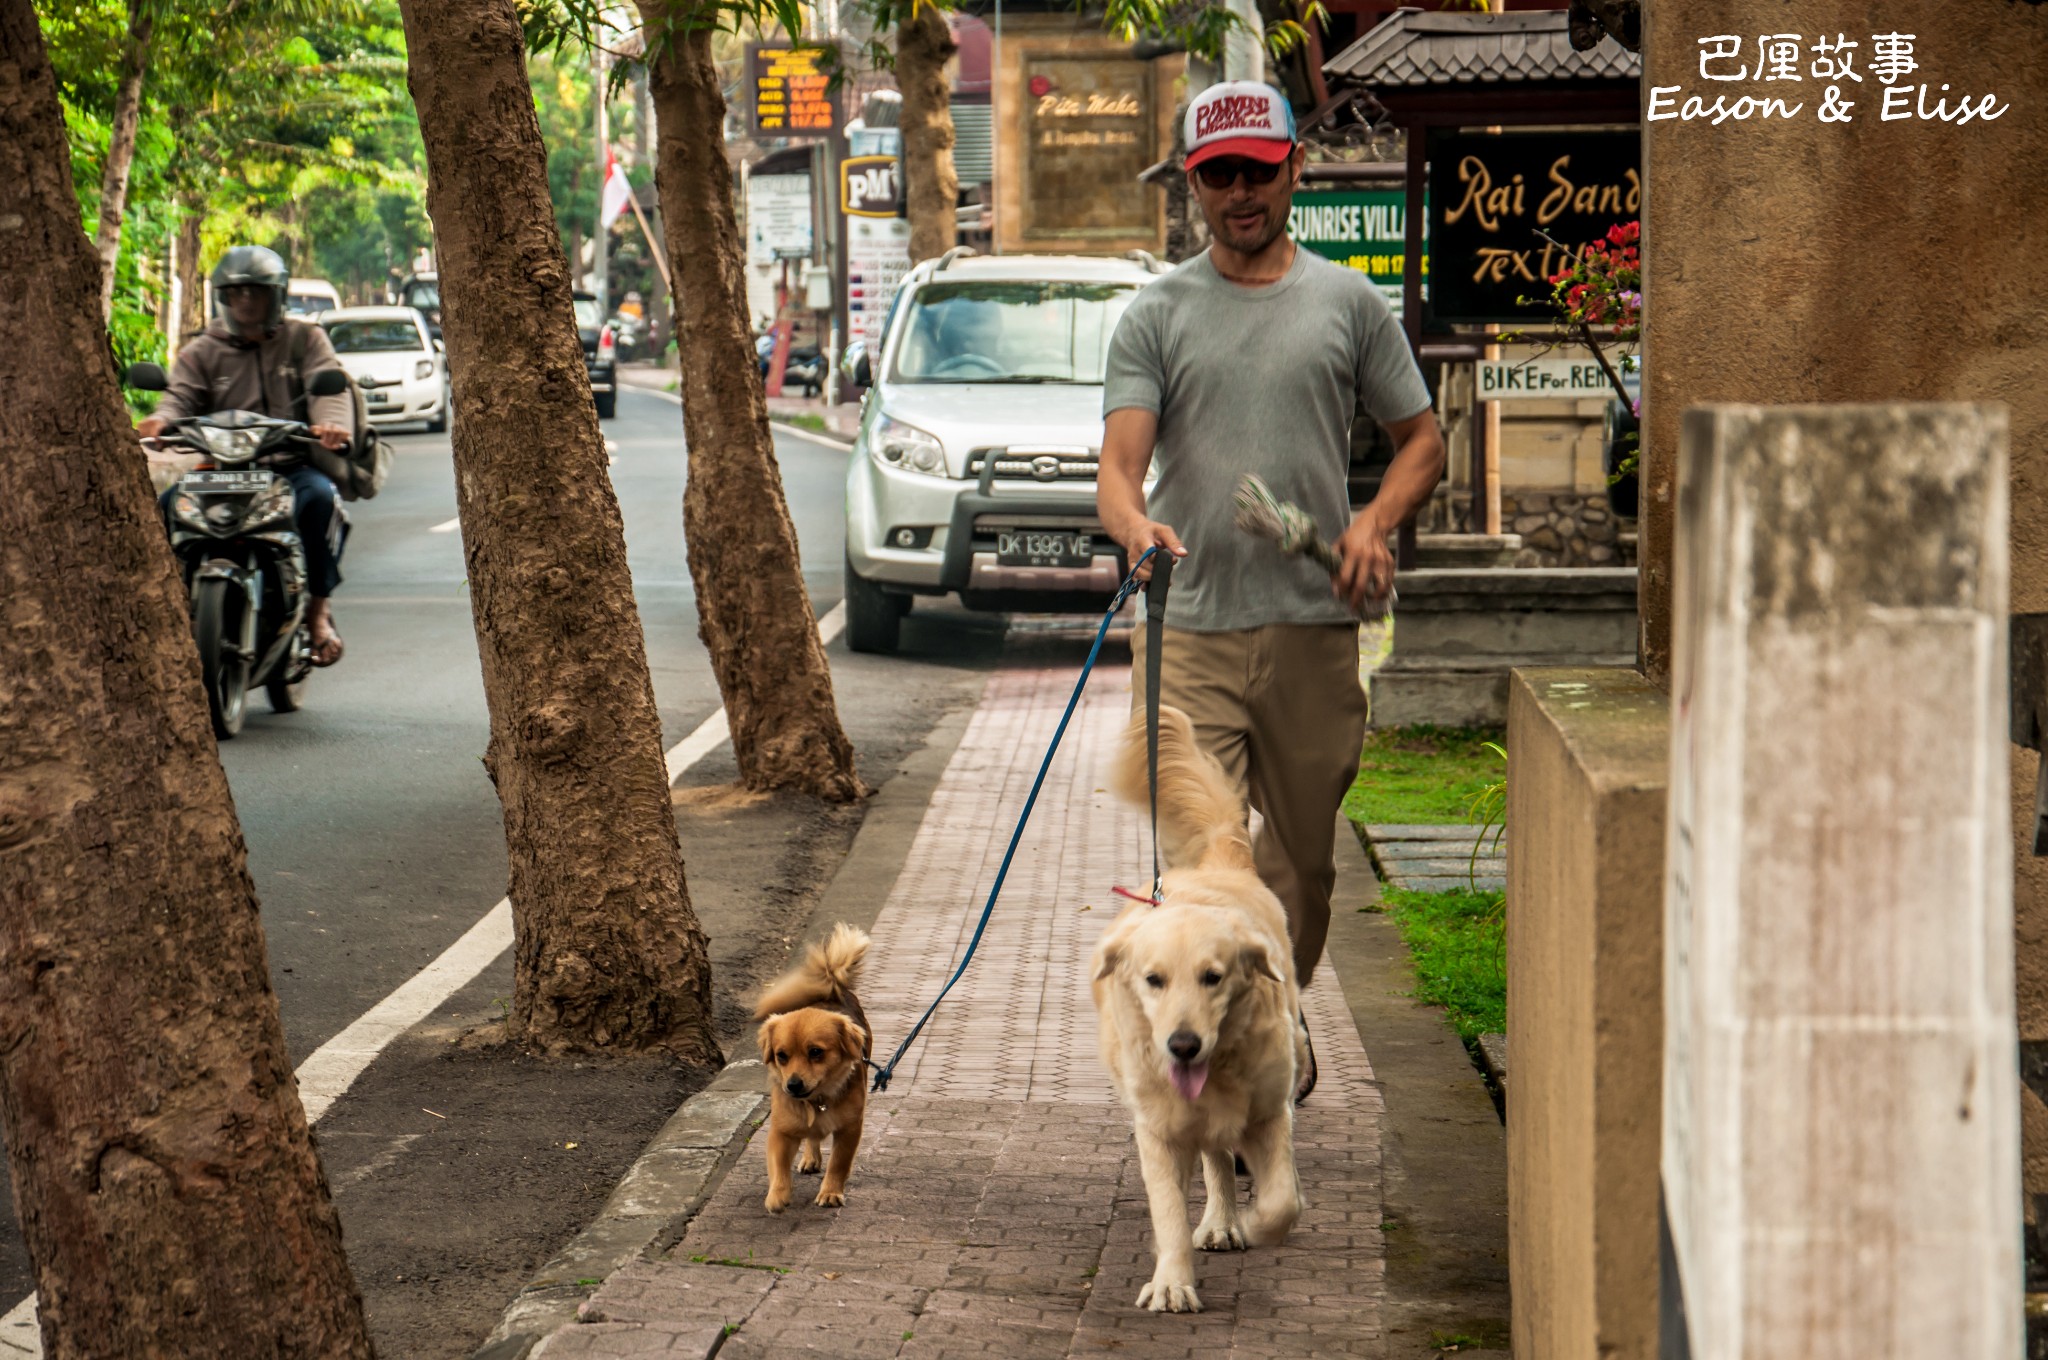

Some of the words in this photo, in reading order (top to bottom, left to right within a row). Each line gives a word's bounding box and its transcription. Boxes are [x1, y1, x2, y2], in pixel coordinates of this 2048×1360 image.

[1445, 155, 1525, 232] Rai
[1287, 205, 1362, 241] SUNRISE
[1483, 365, 1539, 391] BIKE
[998, 533, 1022, 556] DK
[1068, 535, 1091, 557] VE
